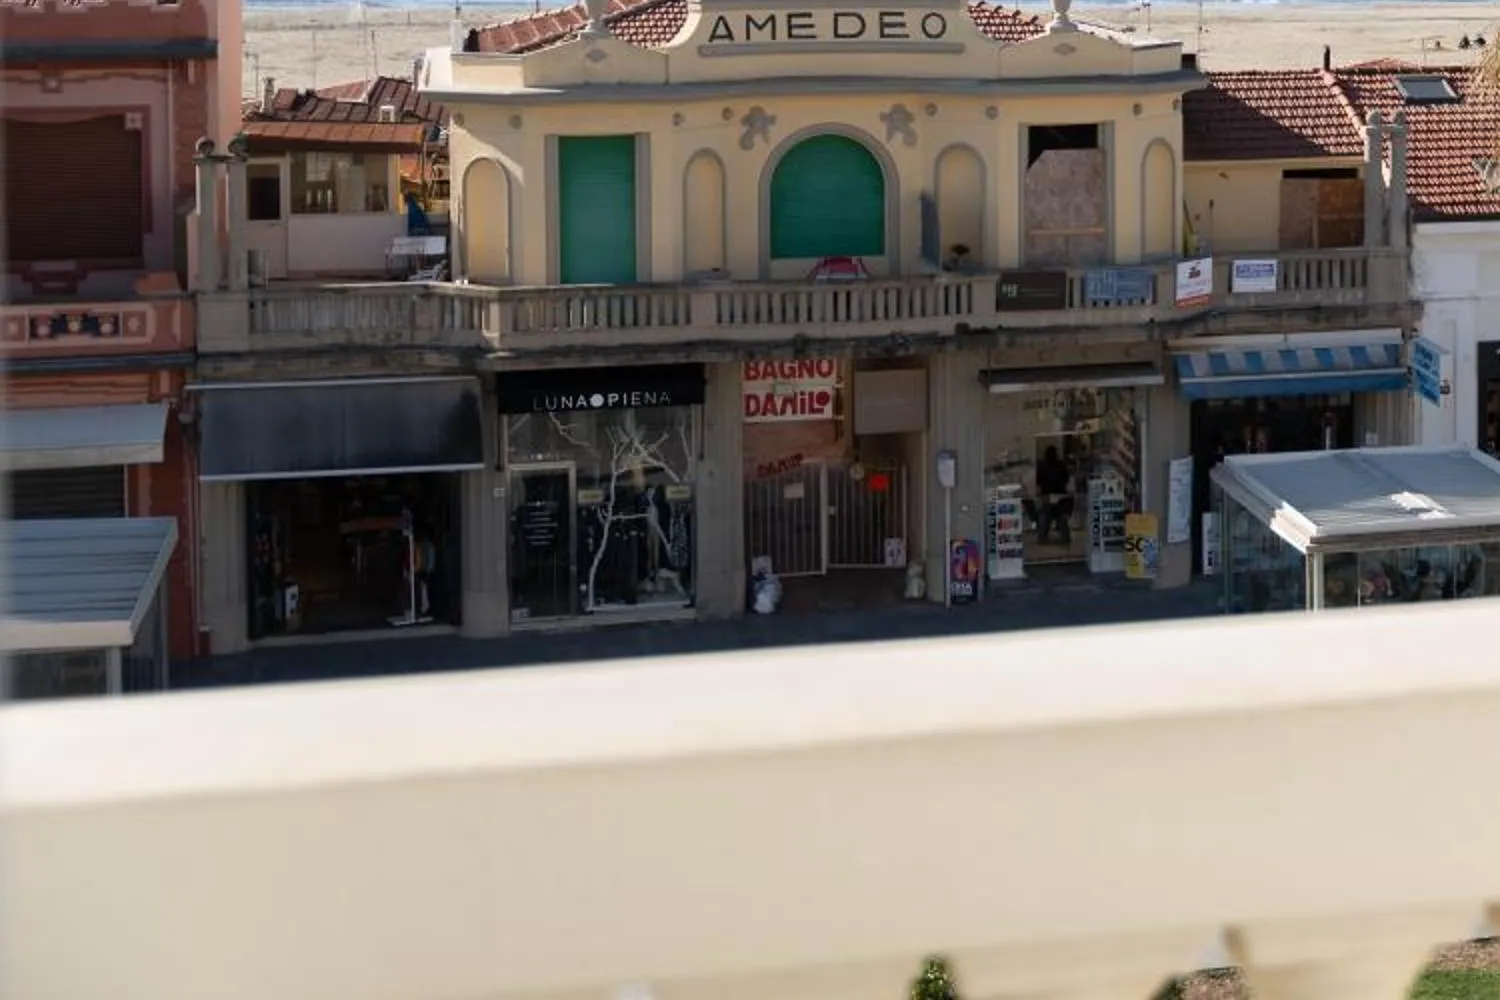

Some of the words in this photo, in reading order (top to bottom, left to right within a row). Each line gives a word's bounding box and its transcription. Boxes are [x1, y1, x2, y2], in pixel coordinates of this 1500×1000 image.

[708, 11, 947, 42] AMEDEO
[743, 359, 834, 381] BAGNO
[533, 395, 587, 411] LUNA
[607, 391, 671, 406] PIENA
